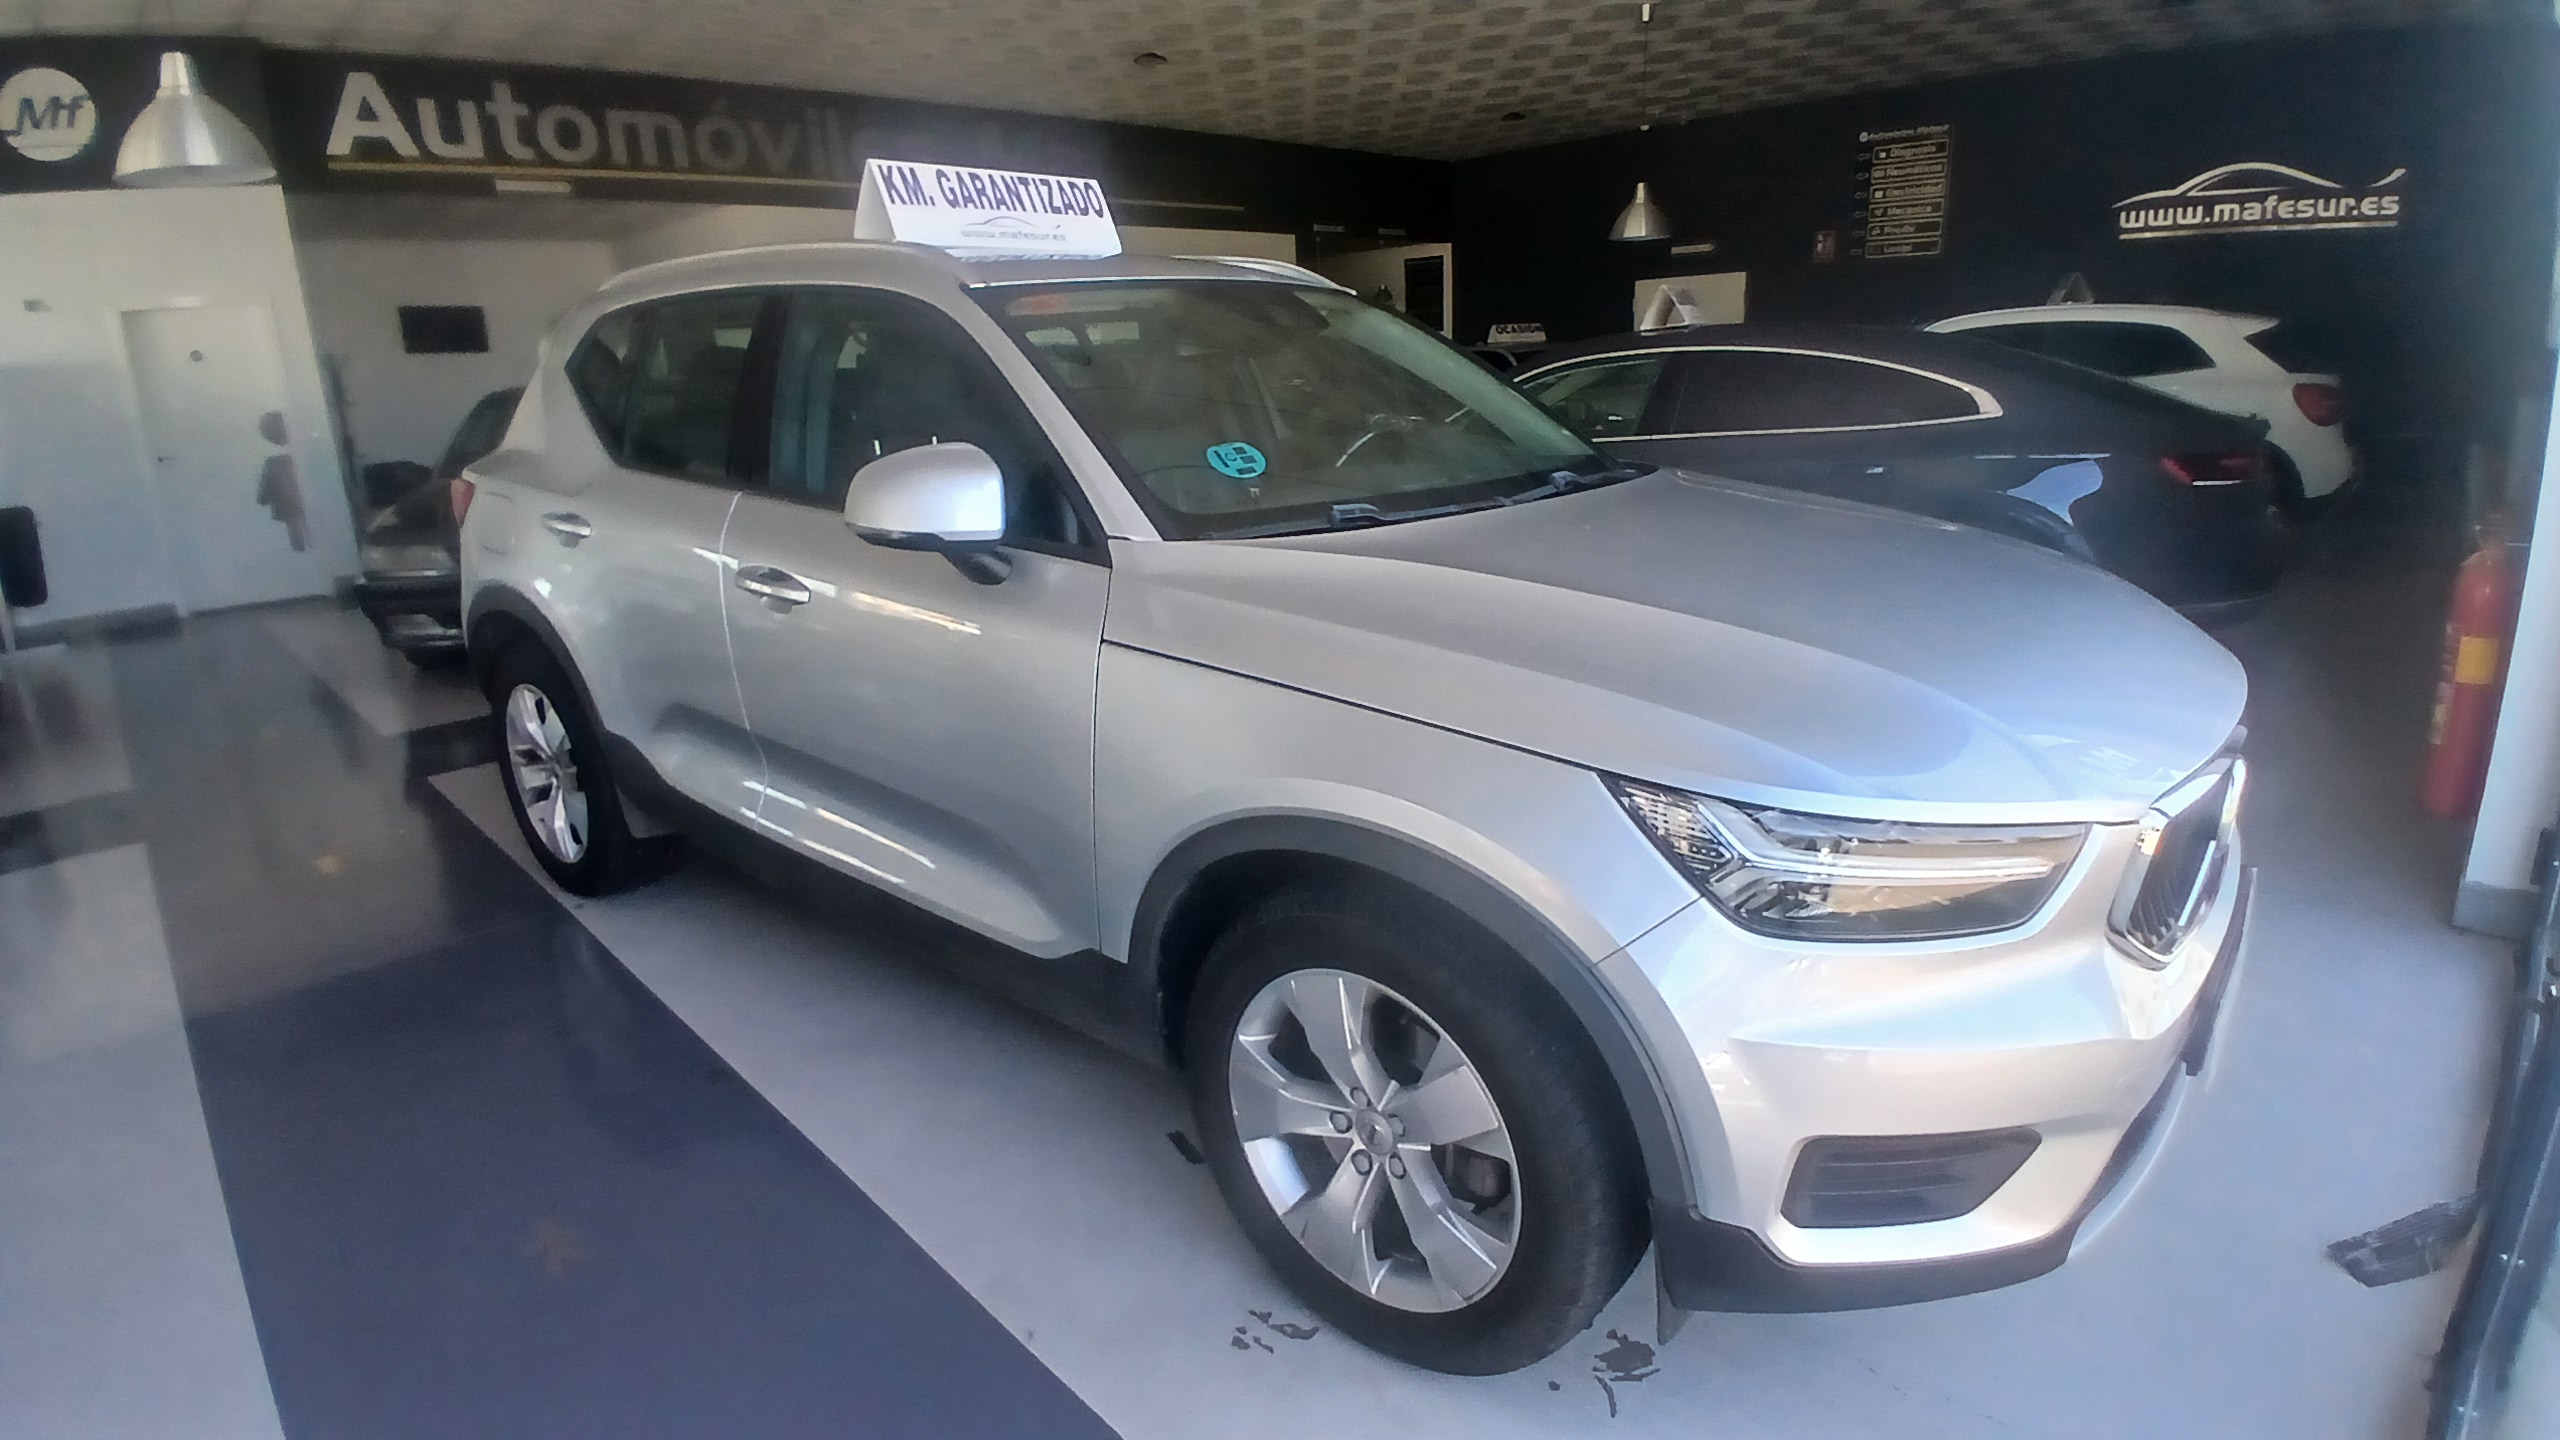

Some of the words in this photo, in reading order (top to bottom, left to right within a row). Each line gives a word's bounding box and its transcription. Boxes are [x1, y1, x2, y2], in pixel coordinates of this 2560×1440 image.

[326, 71, 862, 184] Automóvil
[876, 164, 937, 207] KM.
[935, 168, 1105, 219] GARANTIZADO
[2119, 194, 2400, 229] www.mafesur.es
[960, 228, 1066, 242] www.mafesur.es
